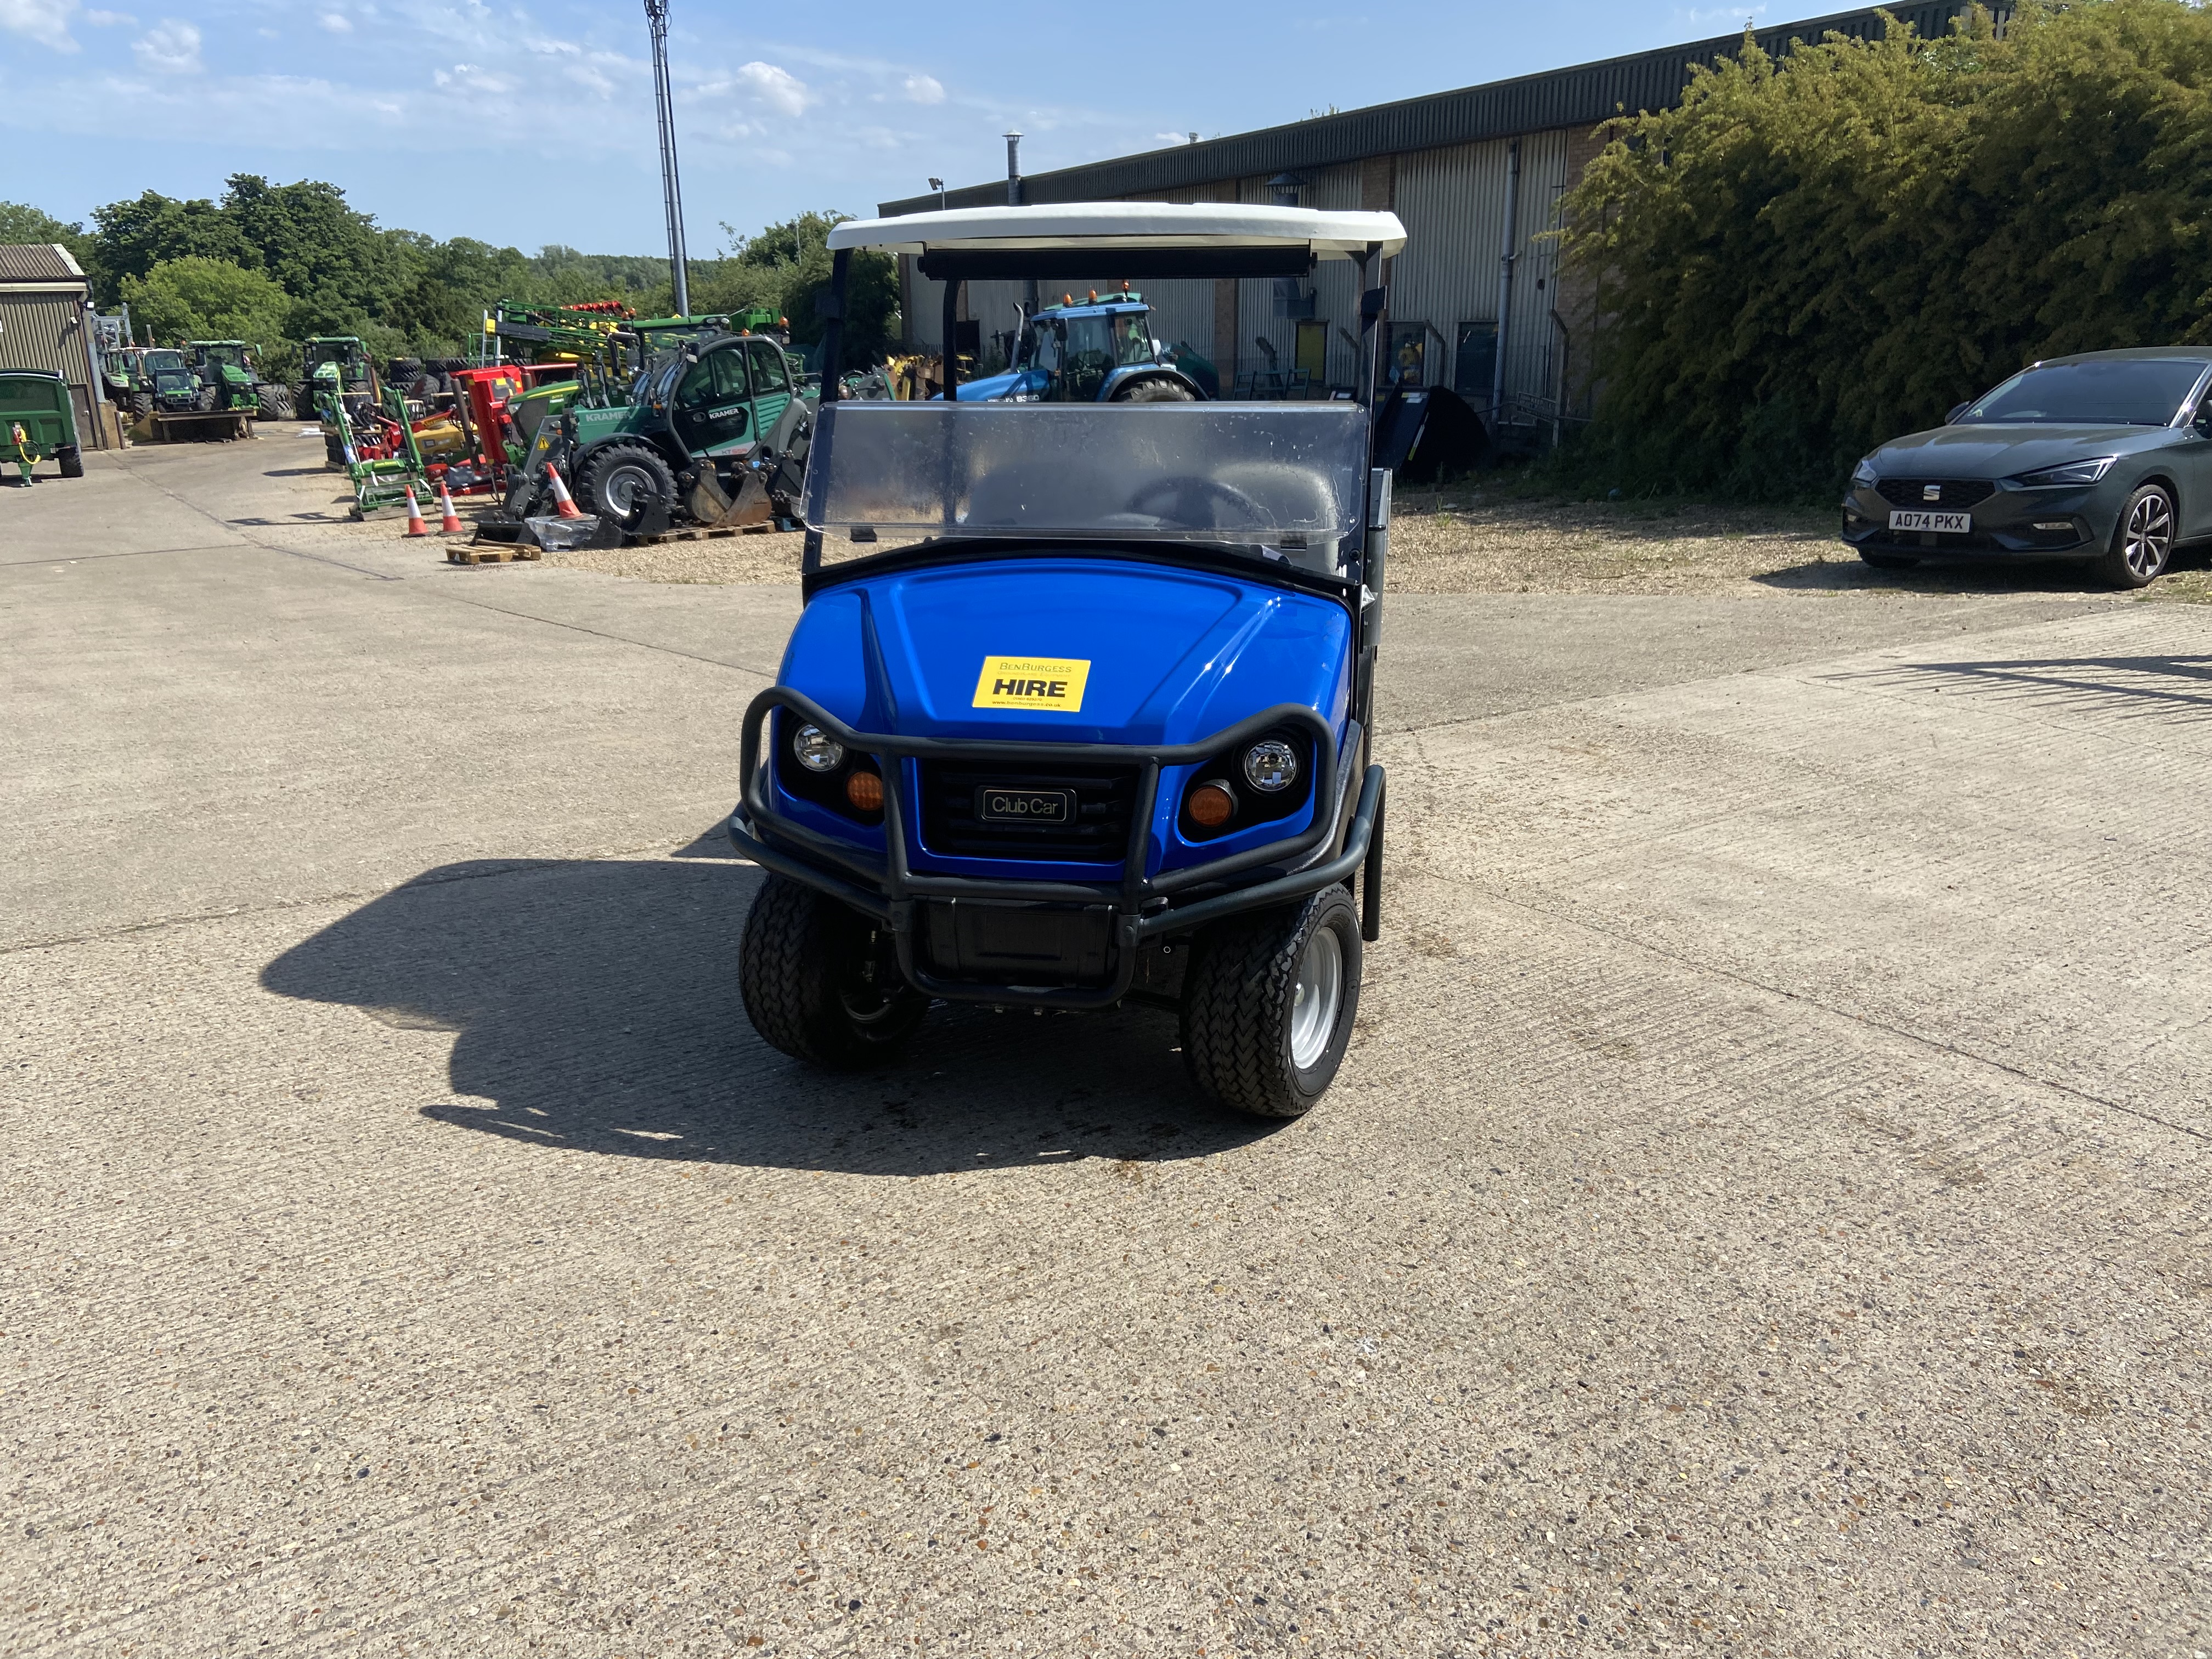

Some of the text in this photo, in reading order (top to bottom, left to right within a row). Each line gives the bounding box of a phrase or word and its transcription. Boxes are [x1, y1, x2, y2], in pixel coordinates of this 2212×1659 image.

[585, 411, 631, 422] KRAMER
[709, 408, 740, 420] KRAMER
[1934, 515, 1964, 529] PKX
[992, 679, 1068, 698] HIRE
[992, 797, 1058, 814] Club Car
